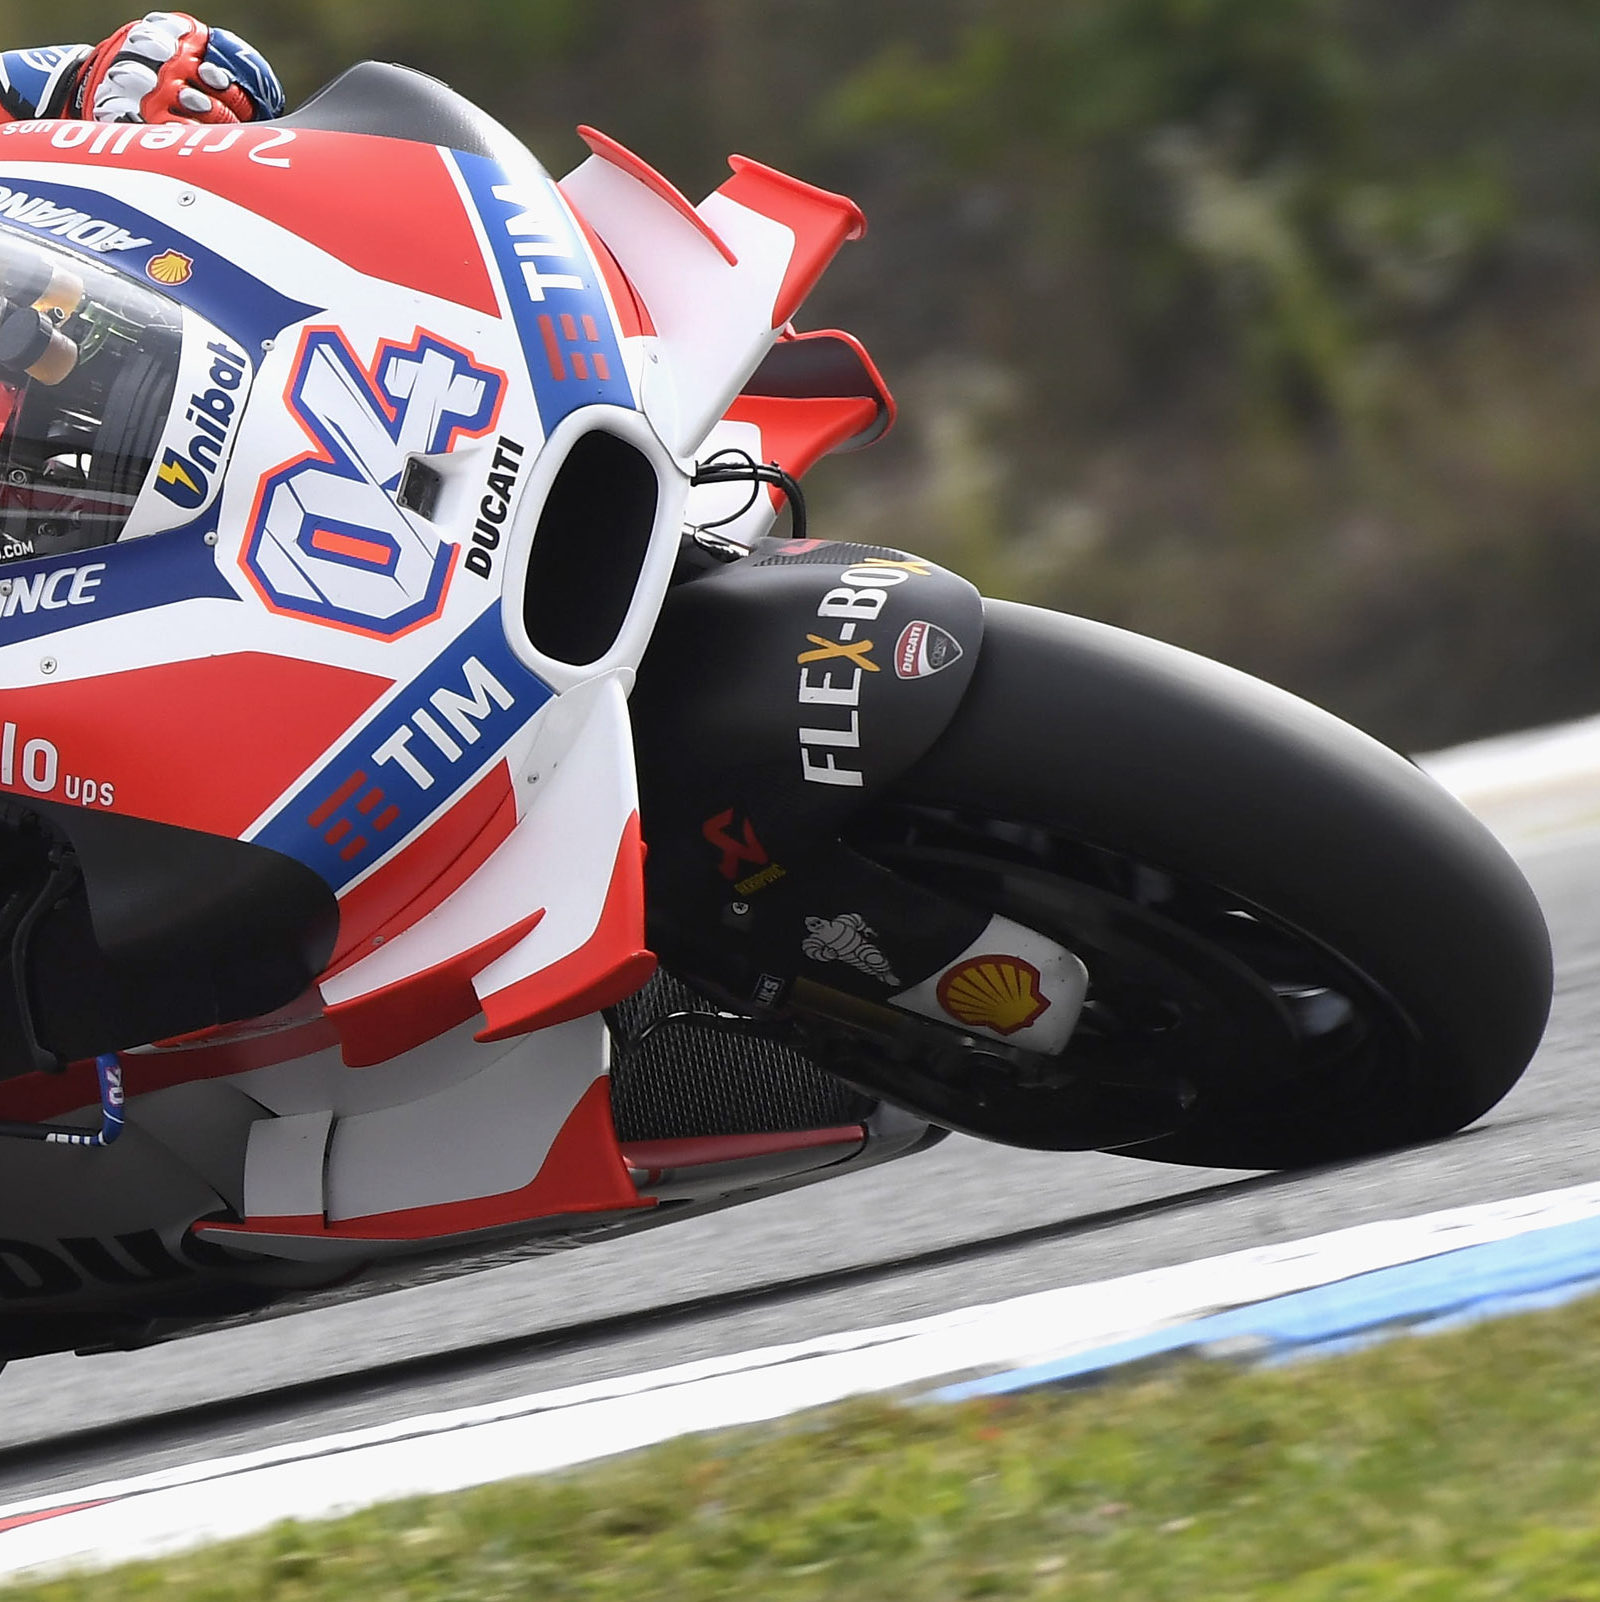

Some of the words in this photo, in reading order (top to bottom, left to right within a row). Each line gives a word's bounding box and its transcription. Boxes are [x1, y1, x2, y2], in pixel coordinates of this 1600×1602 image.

[50, 120, 246, 157] riello
[492, 183, 587, 302] TIM
[153, 340, 248, 510] Unibat
[236, 324, 510, 644] 04
[464, 435, 525, 581] DUCATI
[797, 557, 932, 787] FLEX-BOX
[901, 625, 923, 674] DUCATI
[63, 774, 116, 807] ups
[371, 655, 515, 791] TIM
